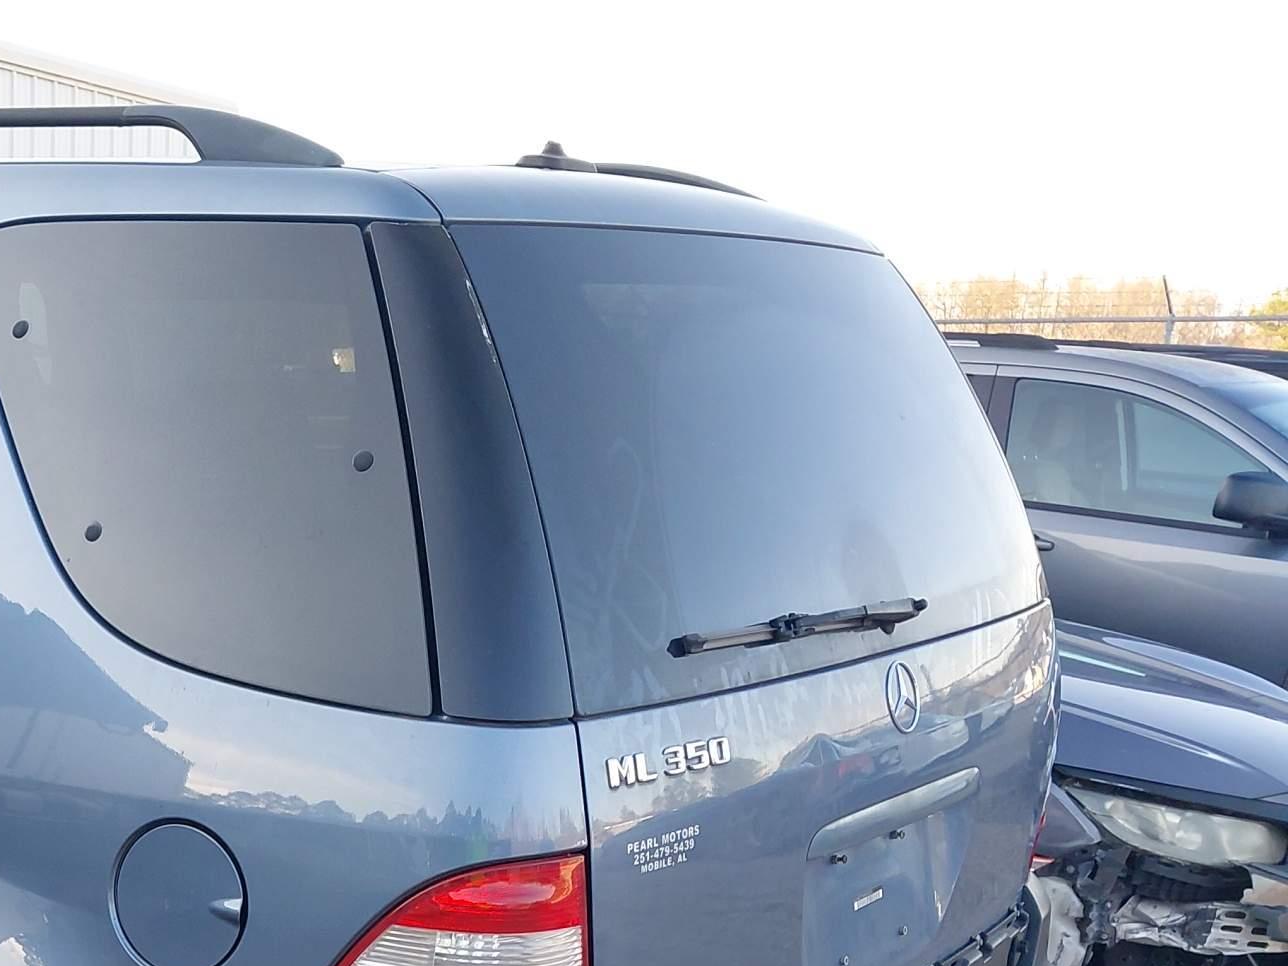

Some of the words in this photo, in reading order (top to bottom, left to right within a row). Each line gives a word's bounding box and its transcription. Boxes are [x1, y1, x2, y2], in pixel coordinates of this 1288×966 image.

[605, 752, 659, 790] ML
[662, 736, 732, 776] 350
[627, 837, 659, 855] PEARL
[661, 824, 700, 846] MOTORS
[633, 838, 695, 866] 251-479-5439
[640, 855, 675, 875] MOBILE,
[677, 852, 688, 864] AL
